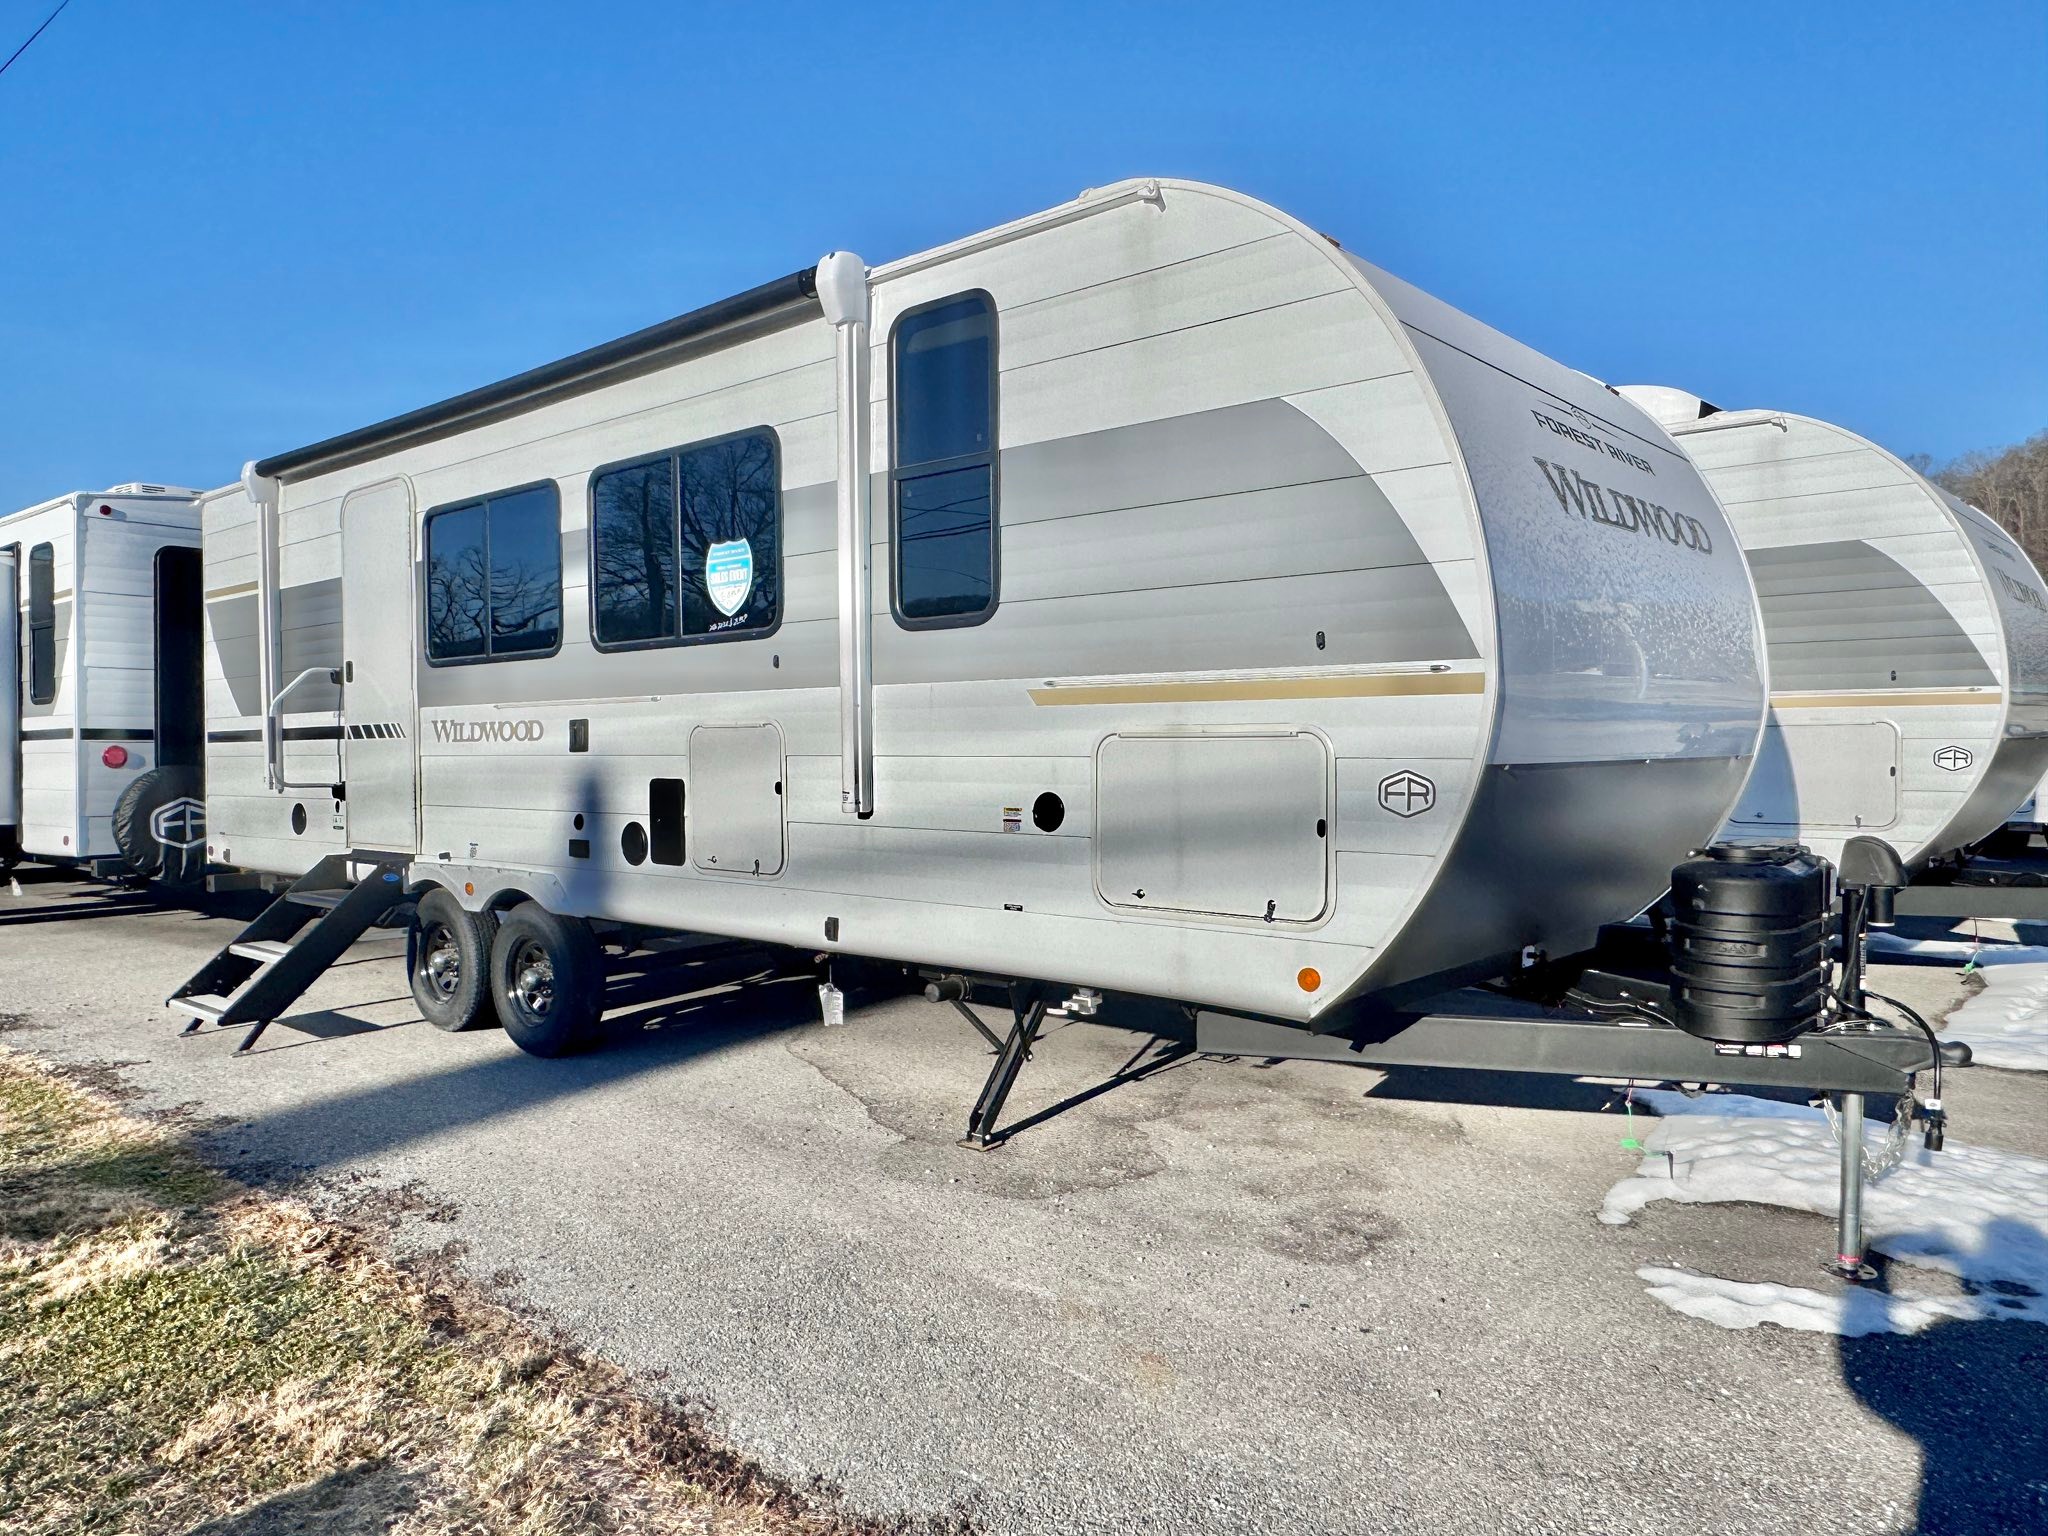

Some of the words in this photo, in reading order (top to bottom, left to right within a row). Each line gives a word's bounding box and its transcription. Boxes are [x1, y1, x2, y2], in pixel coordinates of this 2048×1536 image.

[1530, 409, 1605, 454] FOREST
[1603, 441, 1657, 477] RIVER
[1532, 455, 1713, 555] WILDWOOD
[431, 719, 544, 743] WILDWOOD
[1383, 776, 1430, 812] FR
